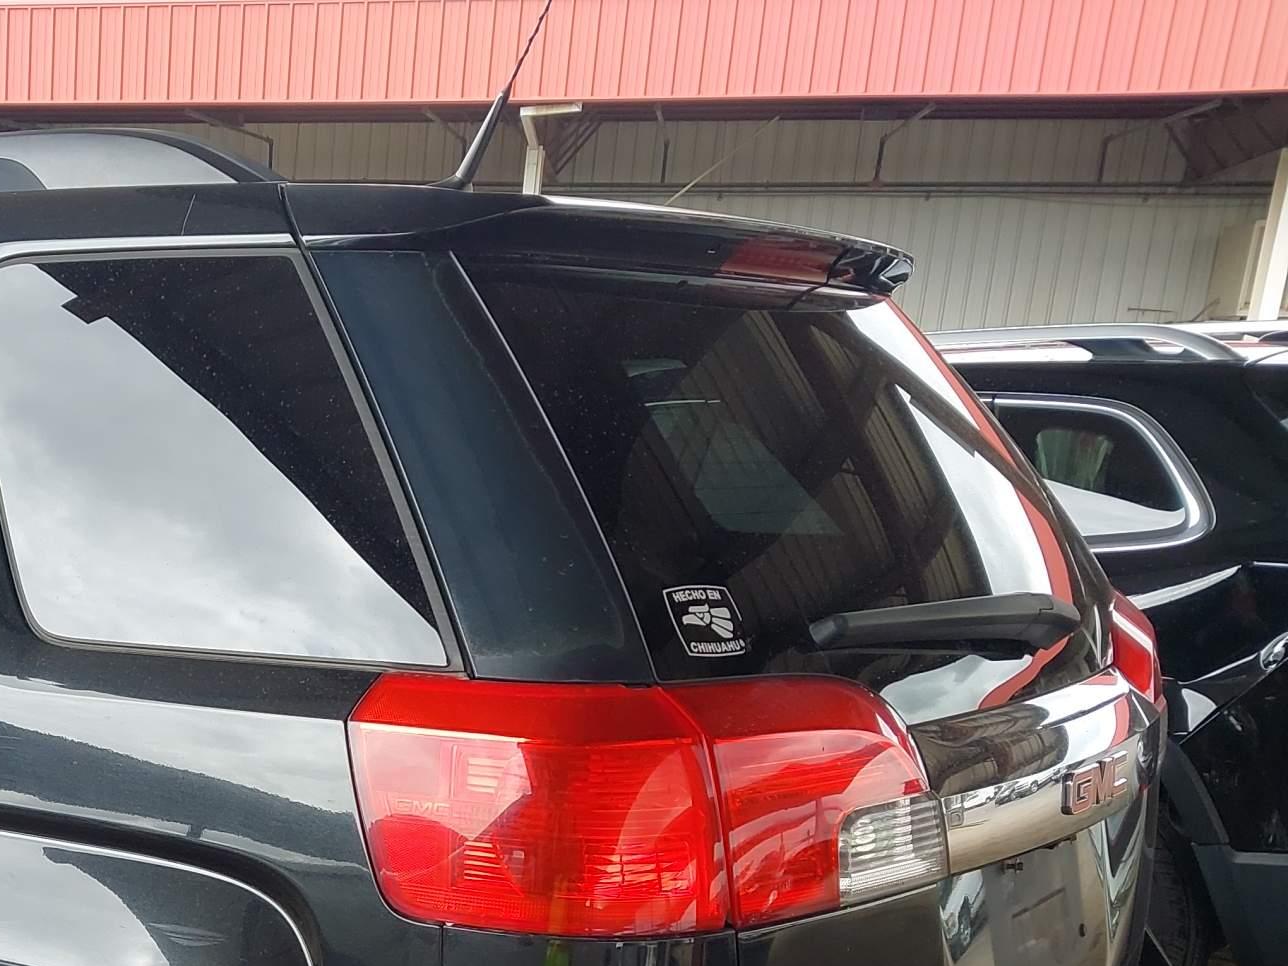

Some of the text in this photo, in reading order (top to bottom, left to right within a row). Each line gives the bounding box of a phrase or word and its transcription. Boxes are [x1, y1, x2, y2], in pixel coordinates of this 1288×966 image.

[672, 590, 721, 602] HECHO EN
[1062, 751, 1129, 815] GMC
[393, 799, 451, 816] GMC
